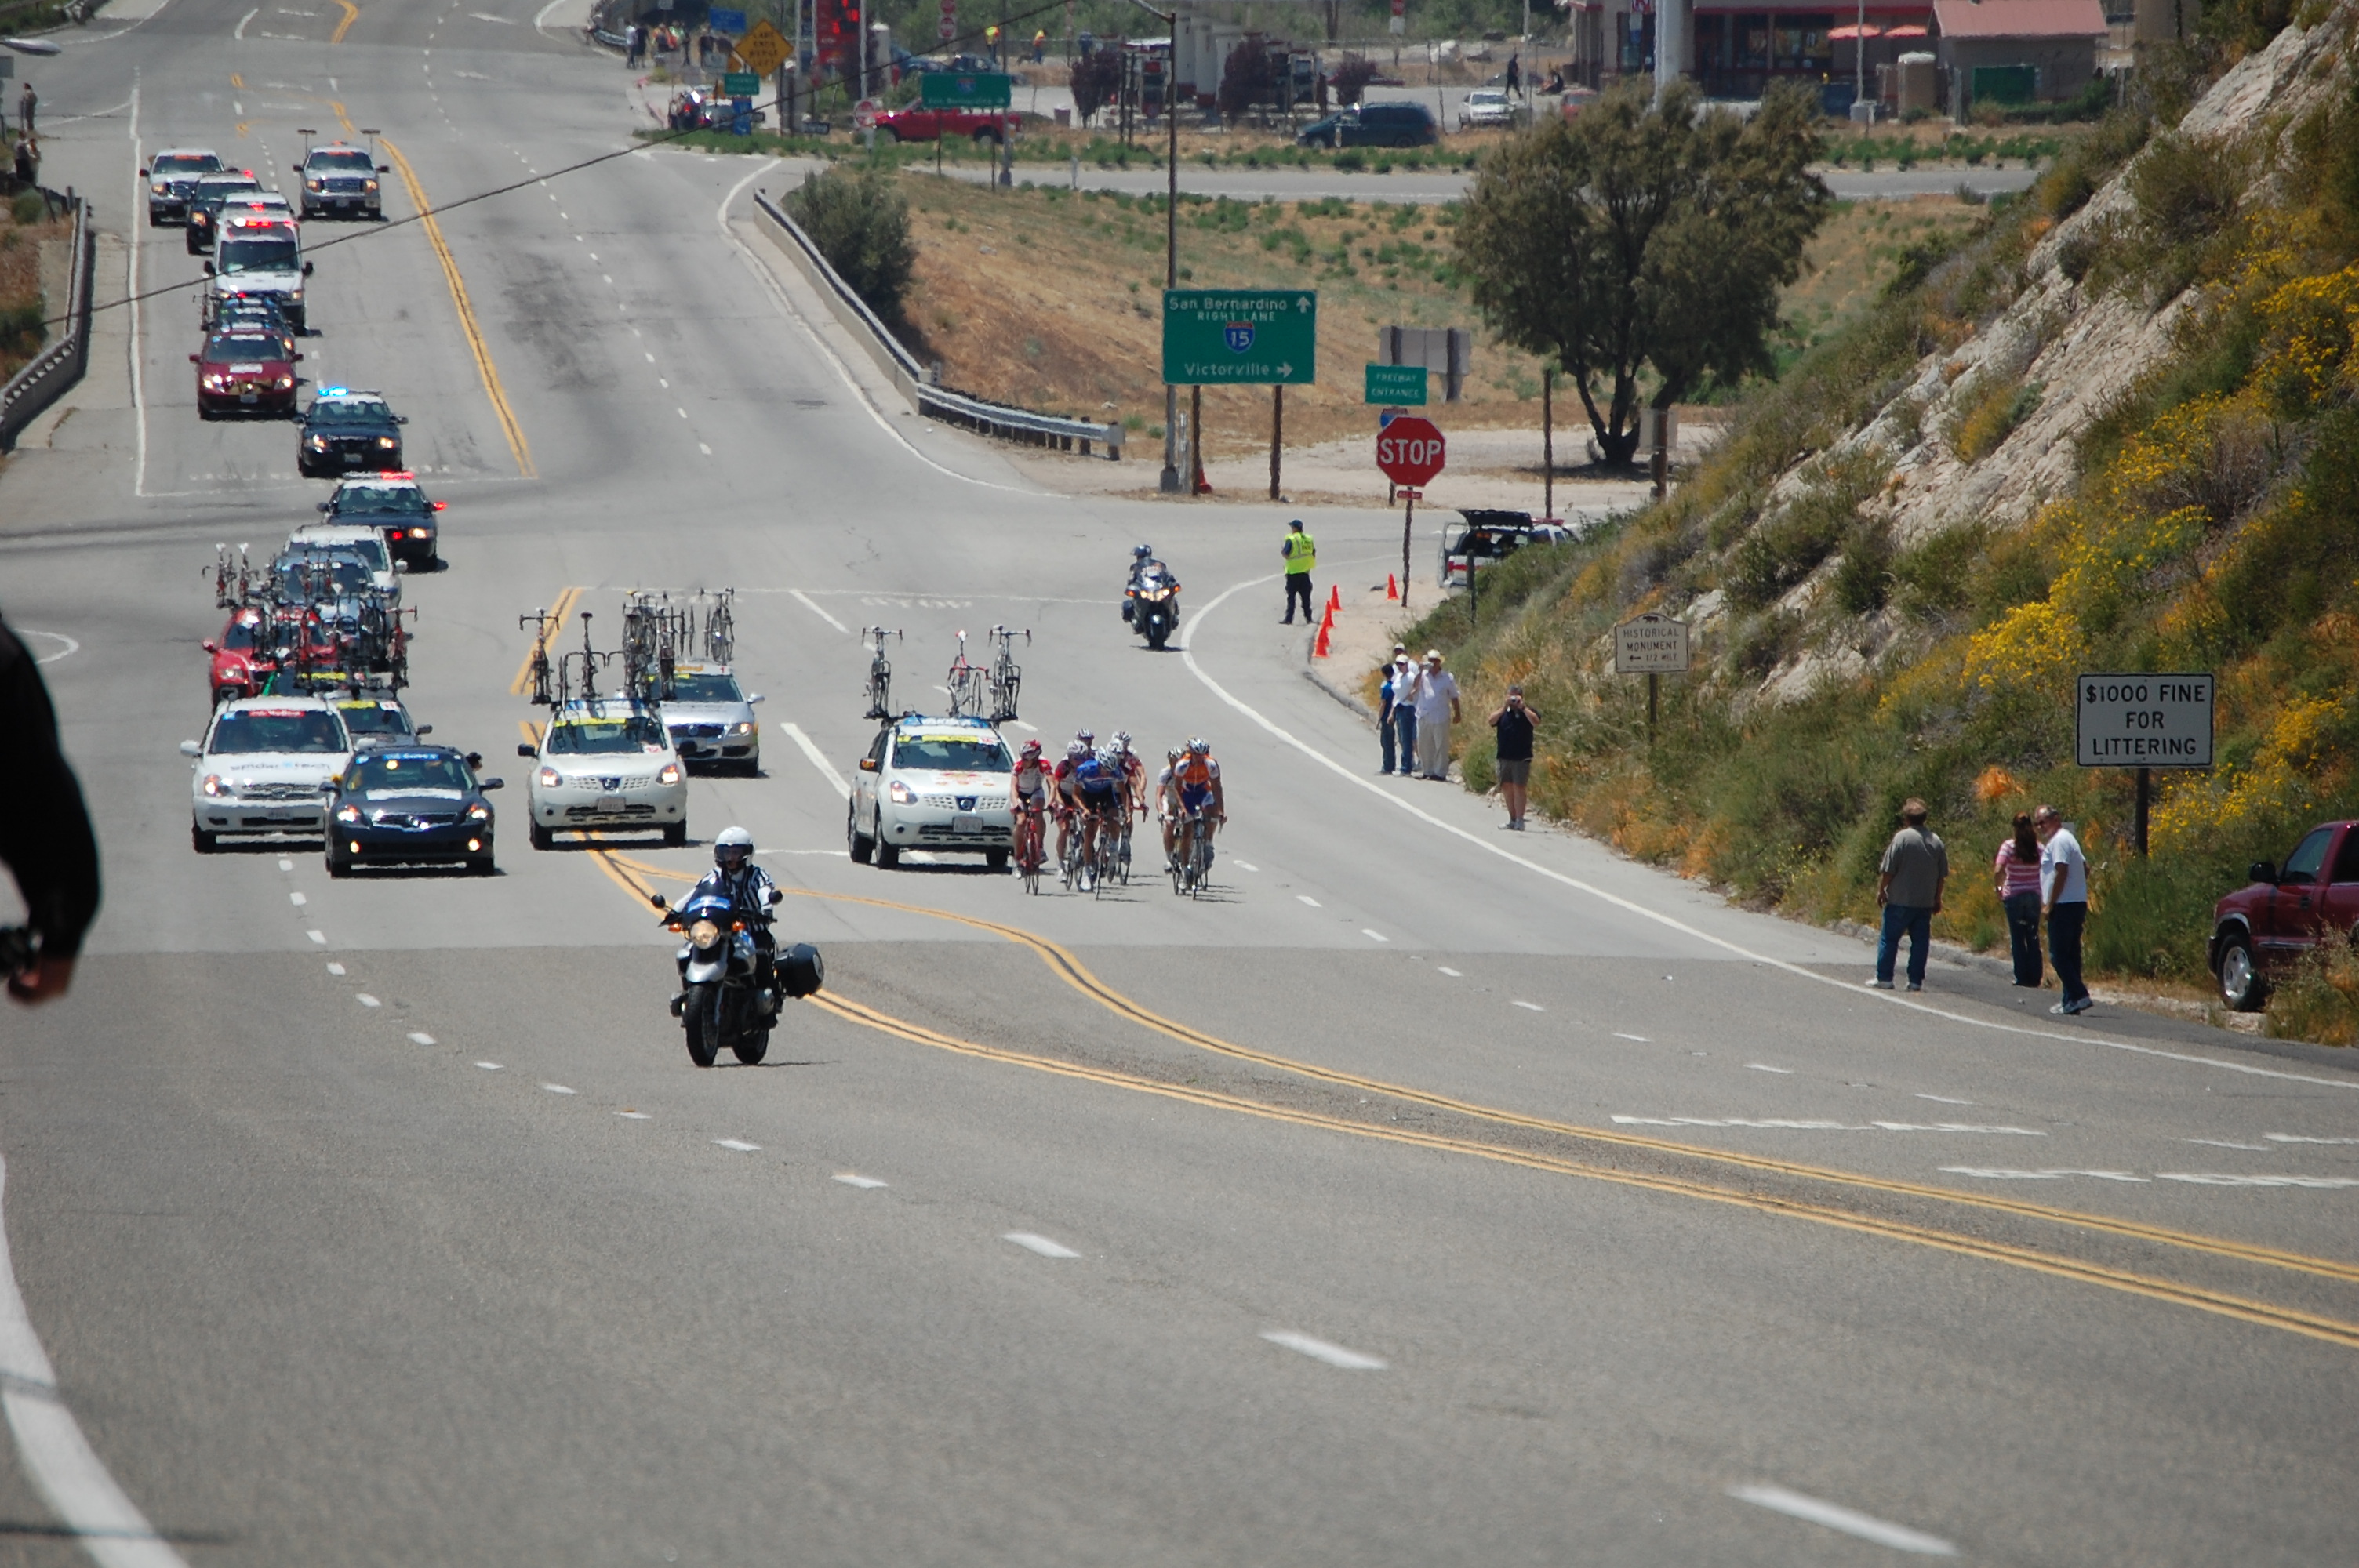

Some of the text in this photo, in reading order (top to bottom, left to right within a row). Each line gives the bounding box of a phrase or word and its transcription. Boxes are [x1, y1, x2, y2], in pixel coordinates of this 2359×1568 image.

[1169, 296, 1288, 310] San Bernardino
[1197, 311, 1276, 321] RIGHT LANE
[1230, 331, 1250, 347] 15
[1184, 362, 1270, 376] Victorville
[1376, 372, 1418, 383] FREEWAY
[1372, 388, 1421, 398] ENTRANCE
[1380, 438, 1441, 466] STOP
[1623, 627, 1680, 639] HISTORICAL
[1626, 641, 1678, 652] MONUMENT
[2085, 684, 2205, 704] $1000 FINE
[2126, 711, 2165, 729] FOR
[2092, 738, 2197, 756] LITTERING
